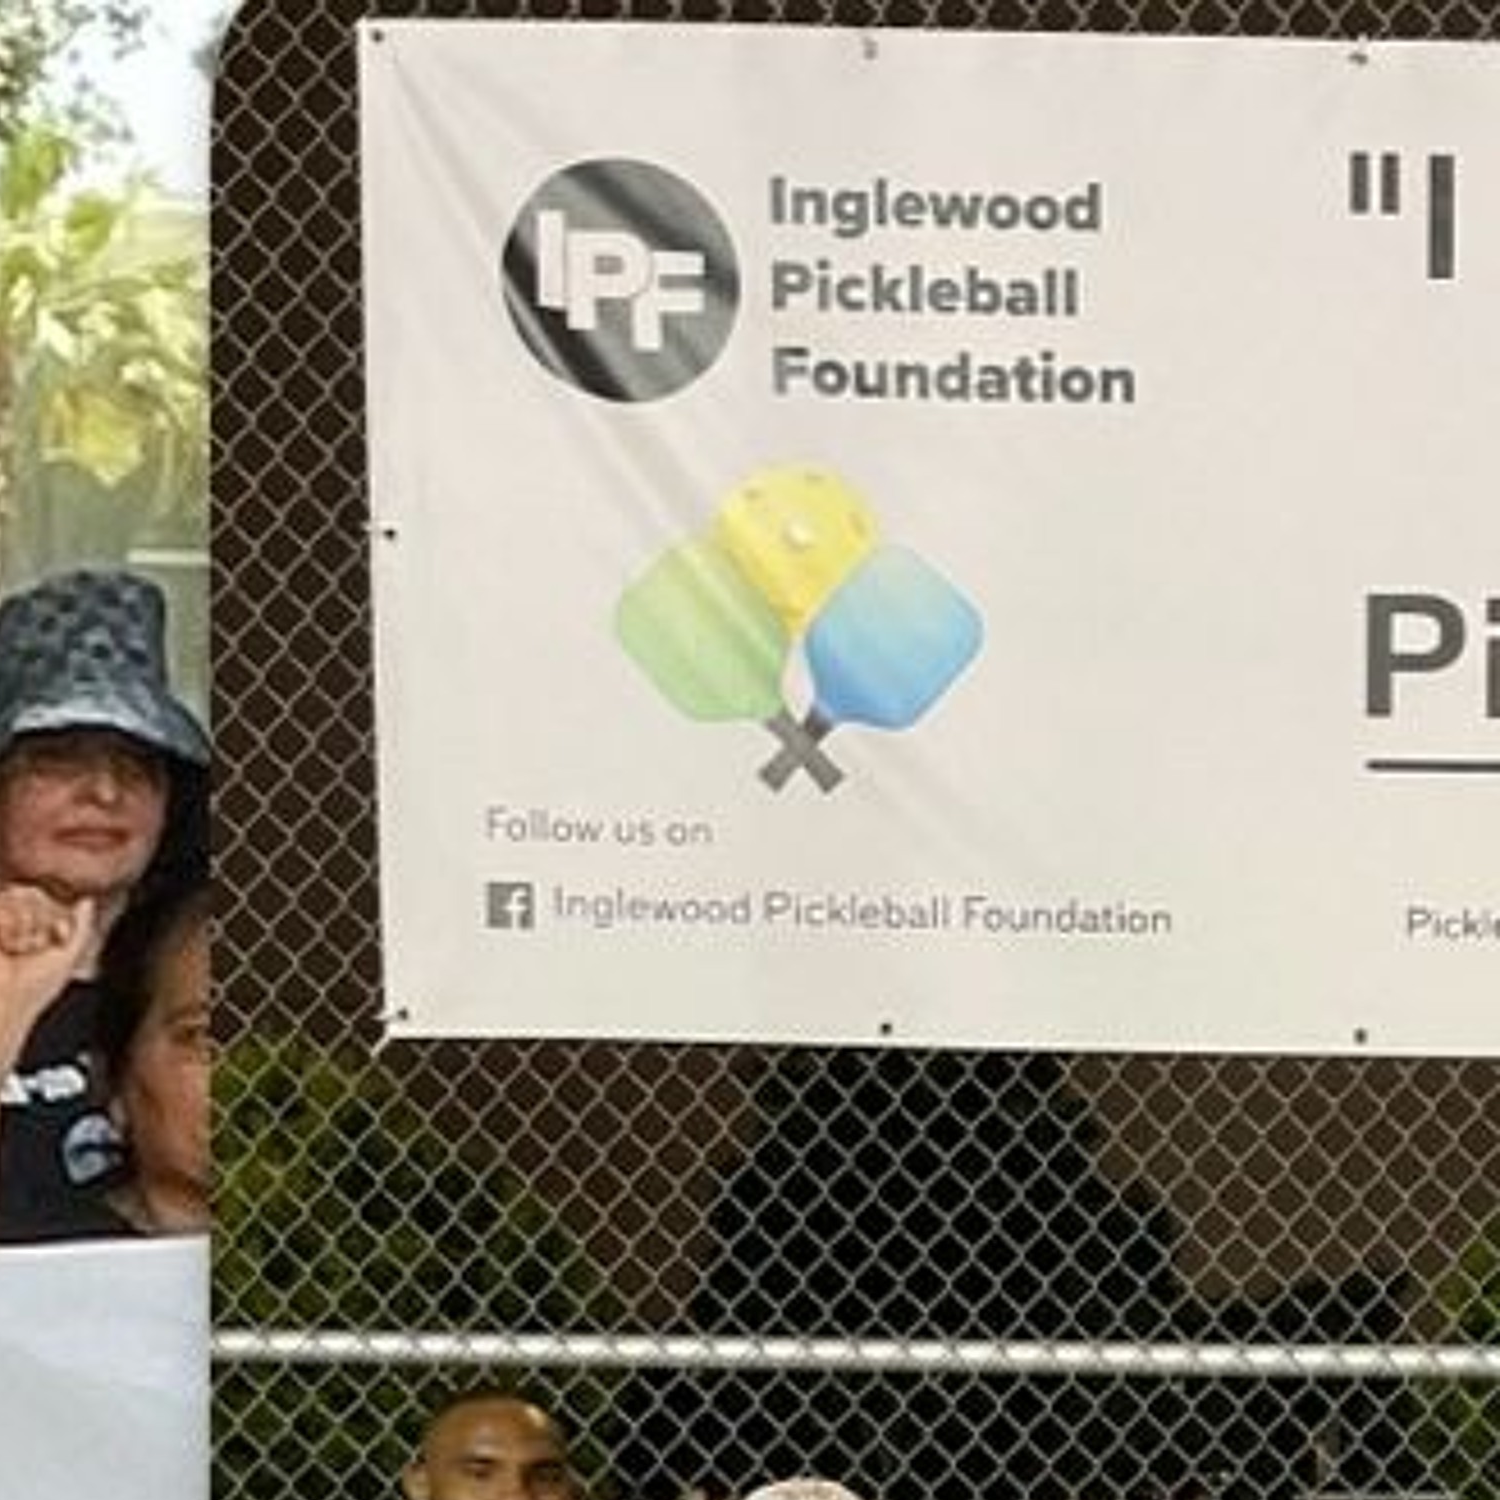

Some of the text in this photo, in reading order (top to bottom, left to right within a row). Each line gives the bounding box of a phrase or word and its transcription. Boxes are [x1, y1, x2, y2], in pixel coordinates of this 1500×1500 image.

[769, 175, 1102, 238] Inglewood
[535, 208, 704, 352] IPF
[770, 259, 1080, 318] Pickleball
[772, 346, 1137, 403] Foundation
[485, 806, 713, 847] Follow us on
[553, 886, 751, 930] Inglewood
[764, 891, 950, 931] Pickleball
[963, 895, 1173, 936] Foundation
